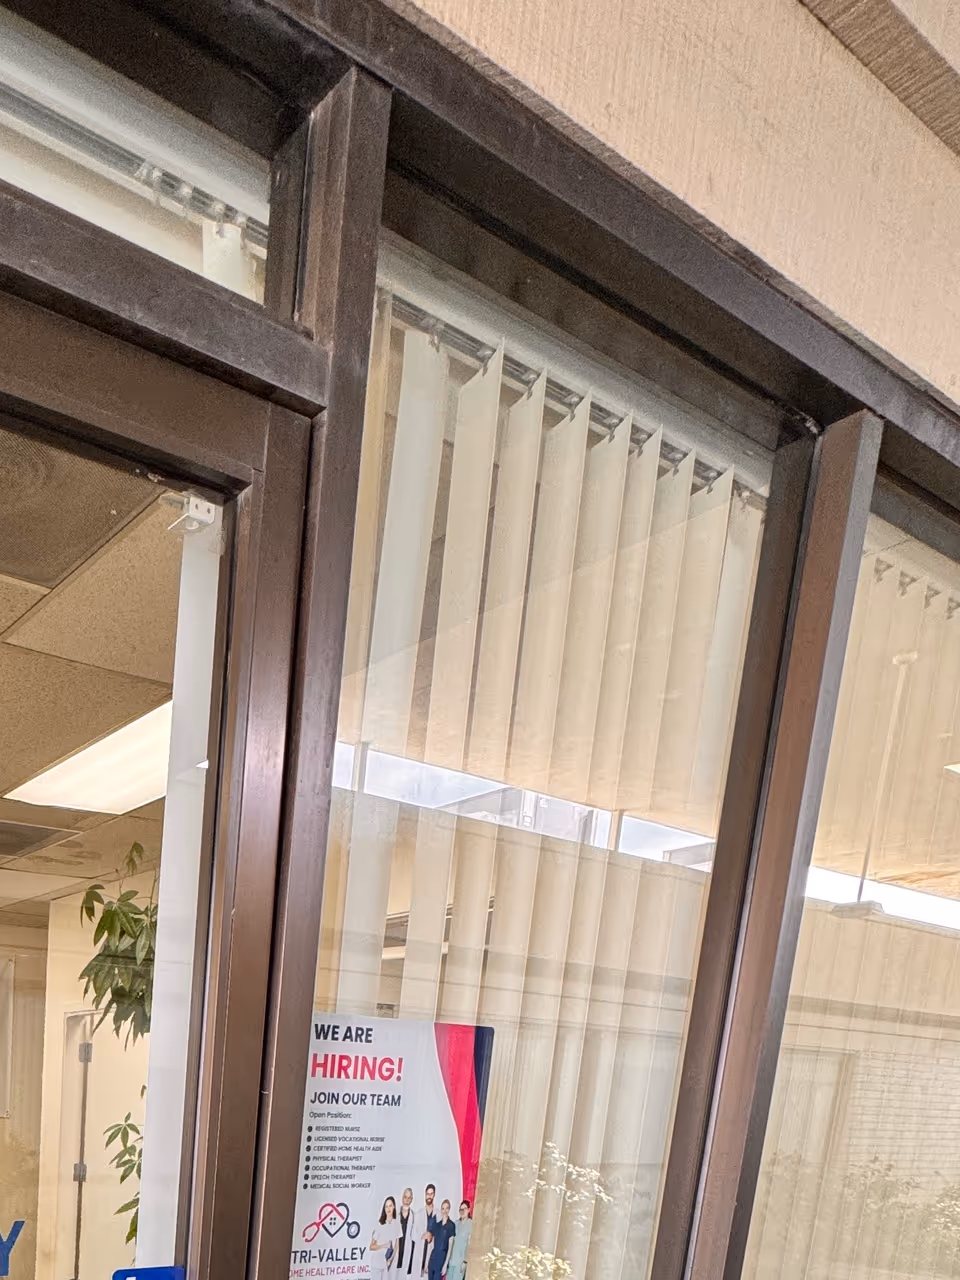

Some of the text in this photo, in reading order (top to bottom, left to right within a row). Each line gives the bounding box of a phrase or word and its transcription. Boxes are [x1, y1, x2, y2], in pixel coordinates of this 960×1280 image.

[315, 1024, 373, 1043] WE ARE
[311, 1053, 403, 1082] HIRING!
[310, 1092, 401, 1106] JOIN OUR TEAM
[292, 1247, 366, 1264] TRI-VALLEY
[289, 1265, 371, 1278] OME HEALTH CARE INC.
